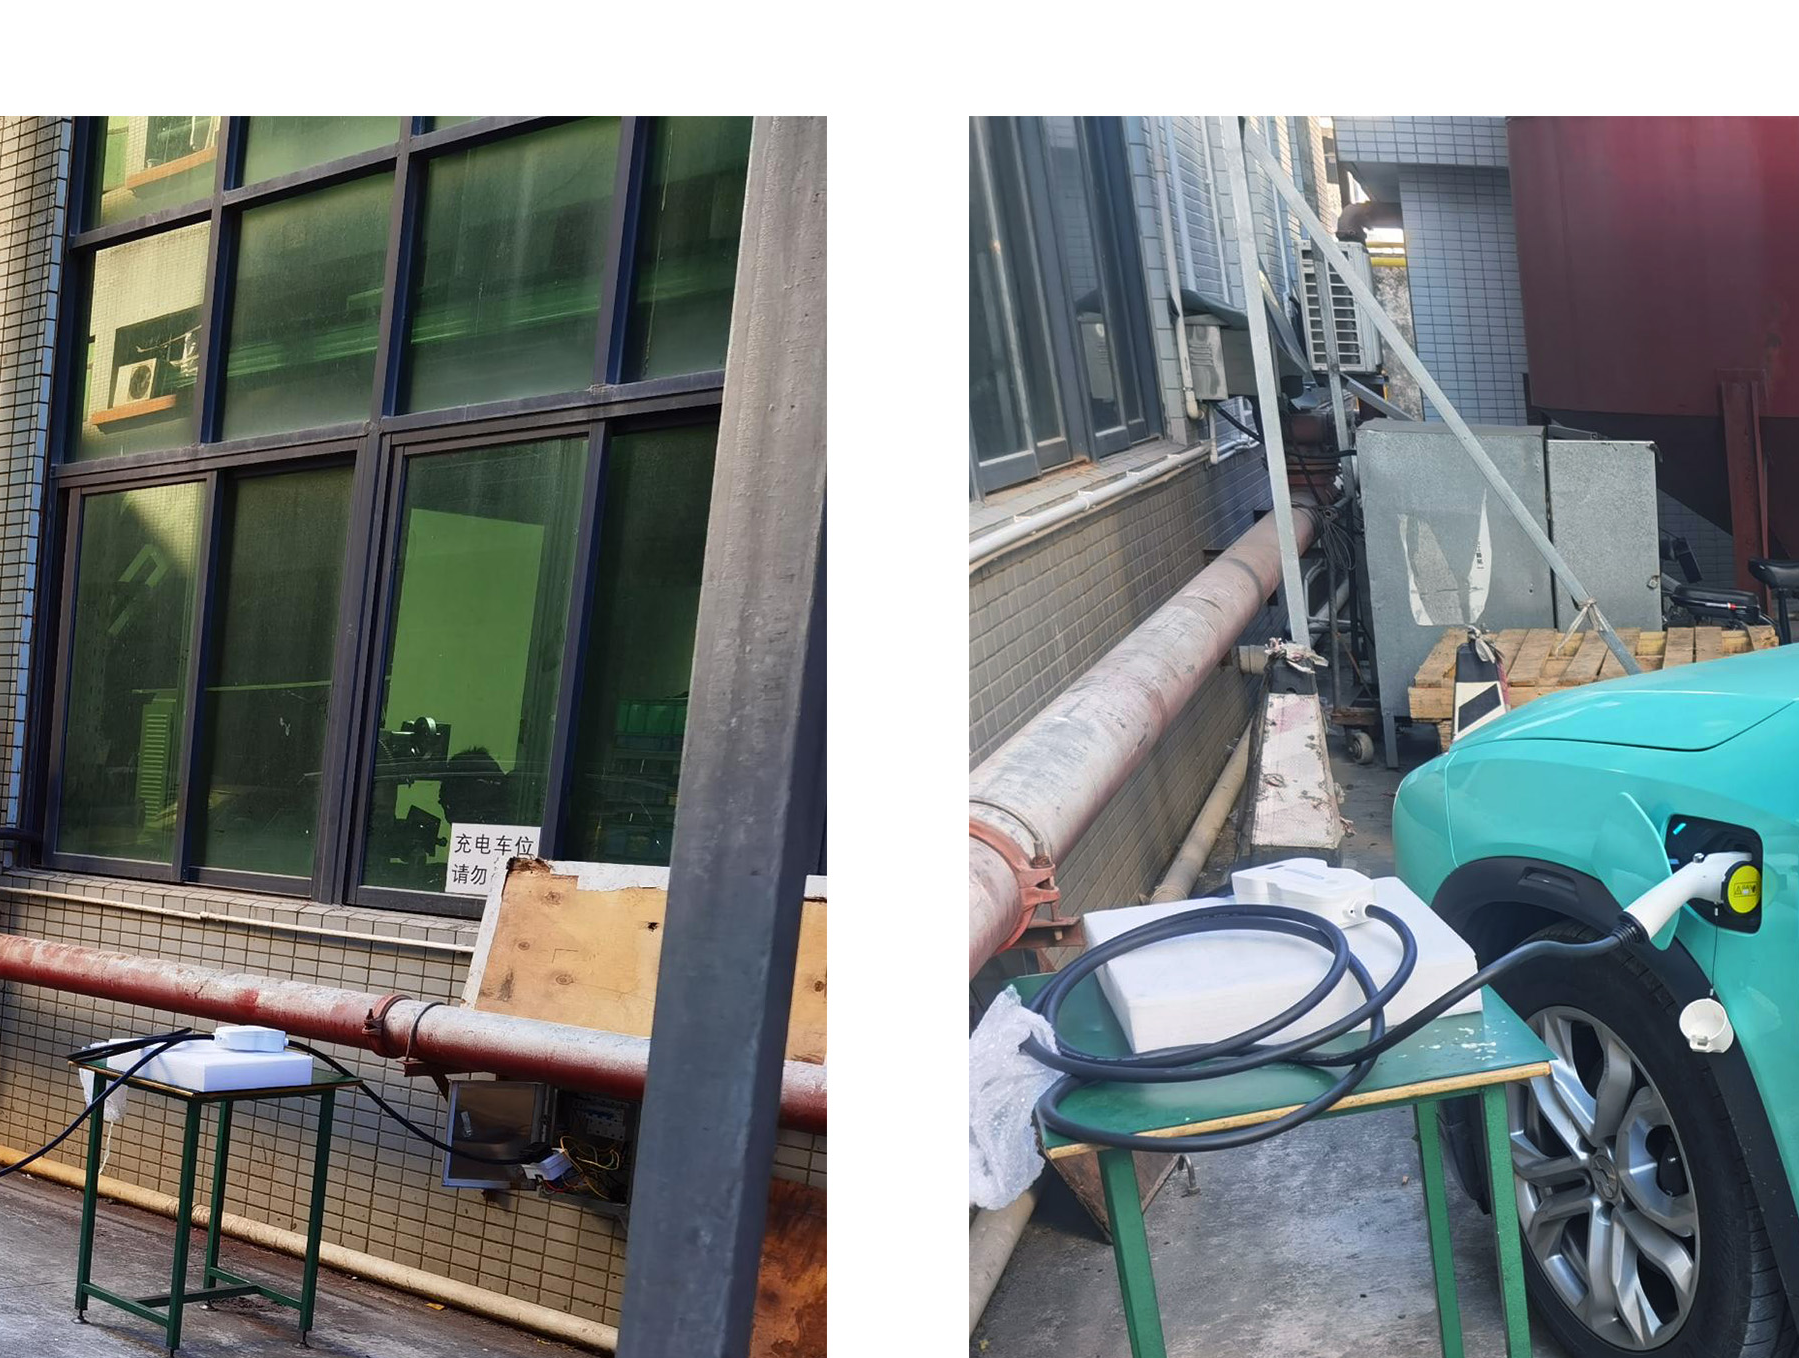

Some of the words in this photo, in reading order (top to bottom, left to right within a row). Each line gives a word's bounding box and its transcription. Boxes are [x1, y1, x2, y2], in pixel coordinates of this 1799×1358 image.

[454, 833, 534, 857] 充电车位
[451, 863, 488, 886] 请勿
